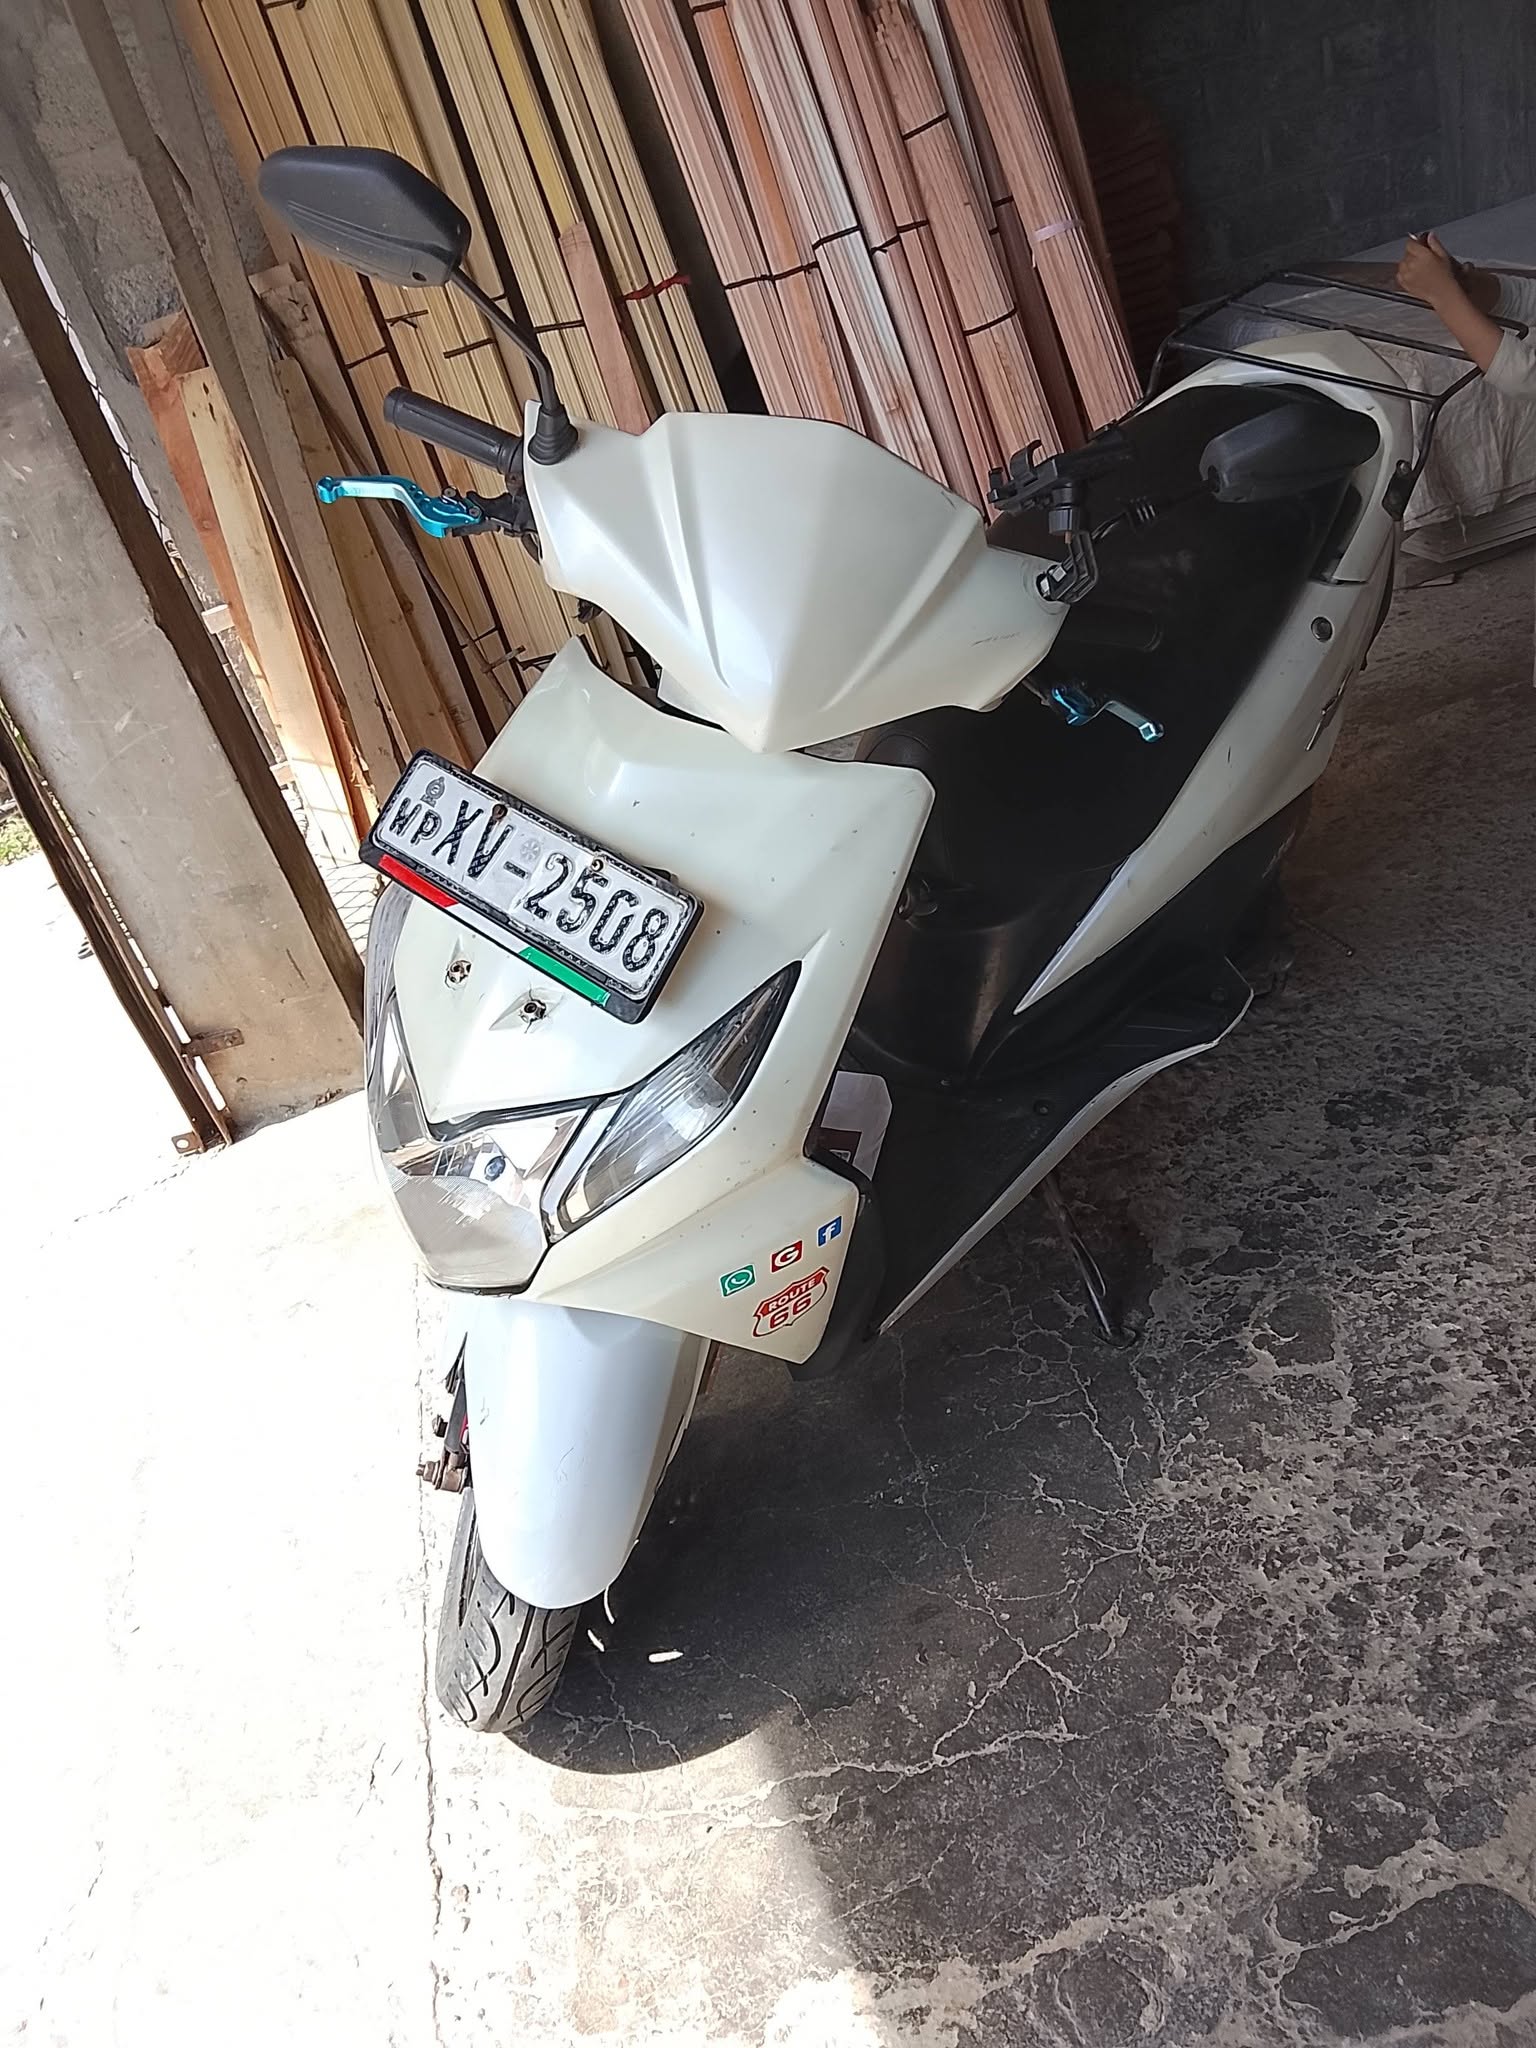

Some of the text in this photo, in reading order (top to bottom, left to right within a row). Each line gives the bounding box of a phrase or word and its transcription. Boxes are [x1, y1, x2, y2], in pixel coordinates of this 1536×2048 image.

[389, 797, 442, 845] WP
[774, 1246, 799, 1267] G
[768, 1278, 816, 1312] ROUTE
[769, 1292, 812, 1329] 66
